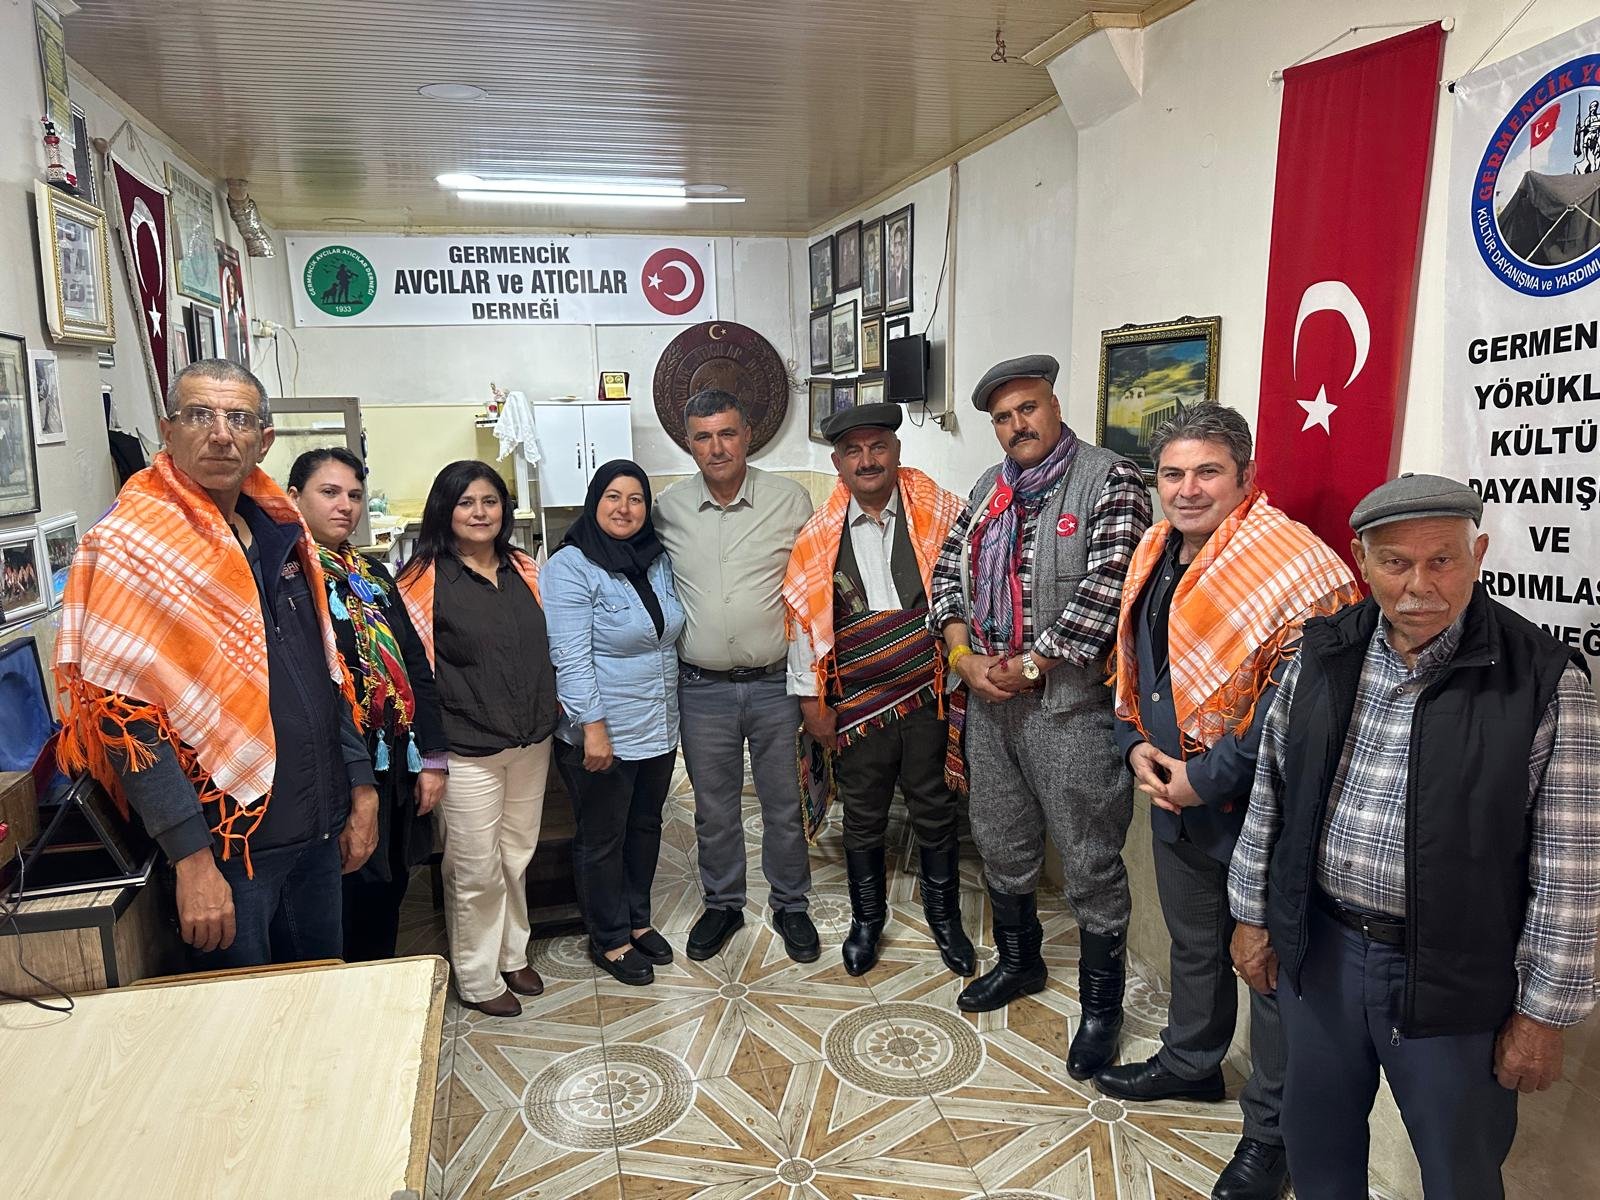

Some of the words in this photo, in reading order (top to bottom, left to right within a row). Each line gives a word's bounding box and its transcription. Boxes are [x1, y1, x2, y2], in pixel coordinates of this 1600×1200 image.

[1479, 71, 1574, 201] GERMENCİK
[315, 248, 341, 262] AVCILAR
[341, 249, 368, 268] ATICILAR
[448, 243, 571, 264] GERMENCİK
[1477, 207, 1497, 254] KÜLTÜR
[1491, 250, 1540, 290] DAYANIŞMA
[1541, 280, 1552, 290] ve
[394, 269, 491, 295] AVCILAR
[496, 274, 524, 295] ve
[531, 269, 628, 294] ATICILAR
[335, 305, 352, 313] 1933
[471, 298, 560, 320] DERNEĞİ
[1468, 320, 1598, 365] GERMEN
[1474, 372, 1600, 410] YÖRÜKL
[1490, 418, 1598, 457] KÜLTÜ
[1468, 476, 1600, 511] DAYANIŞ
[1528, 526, 1571, 554] VE
